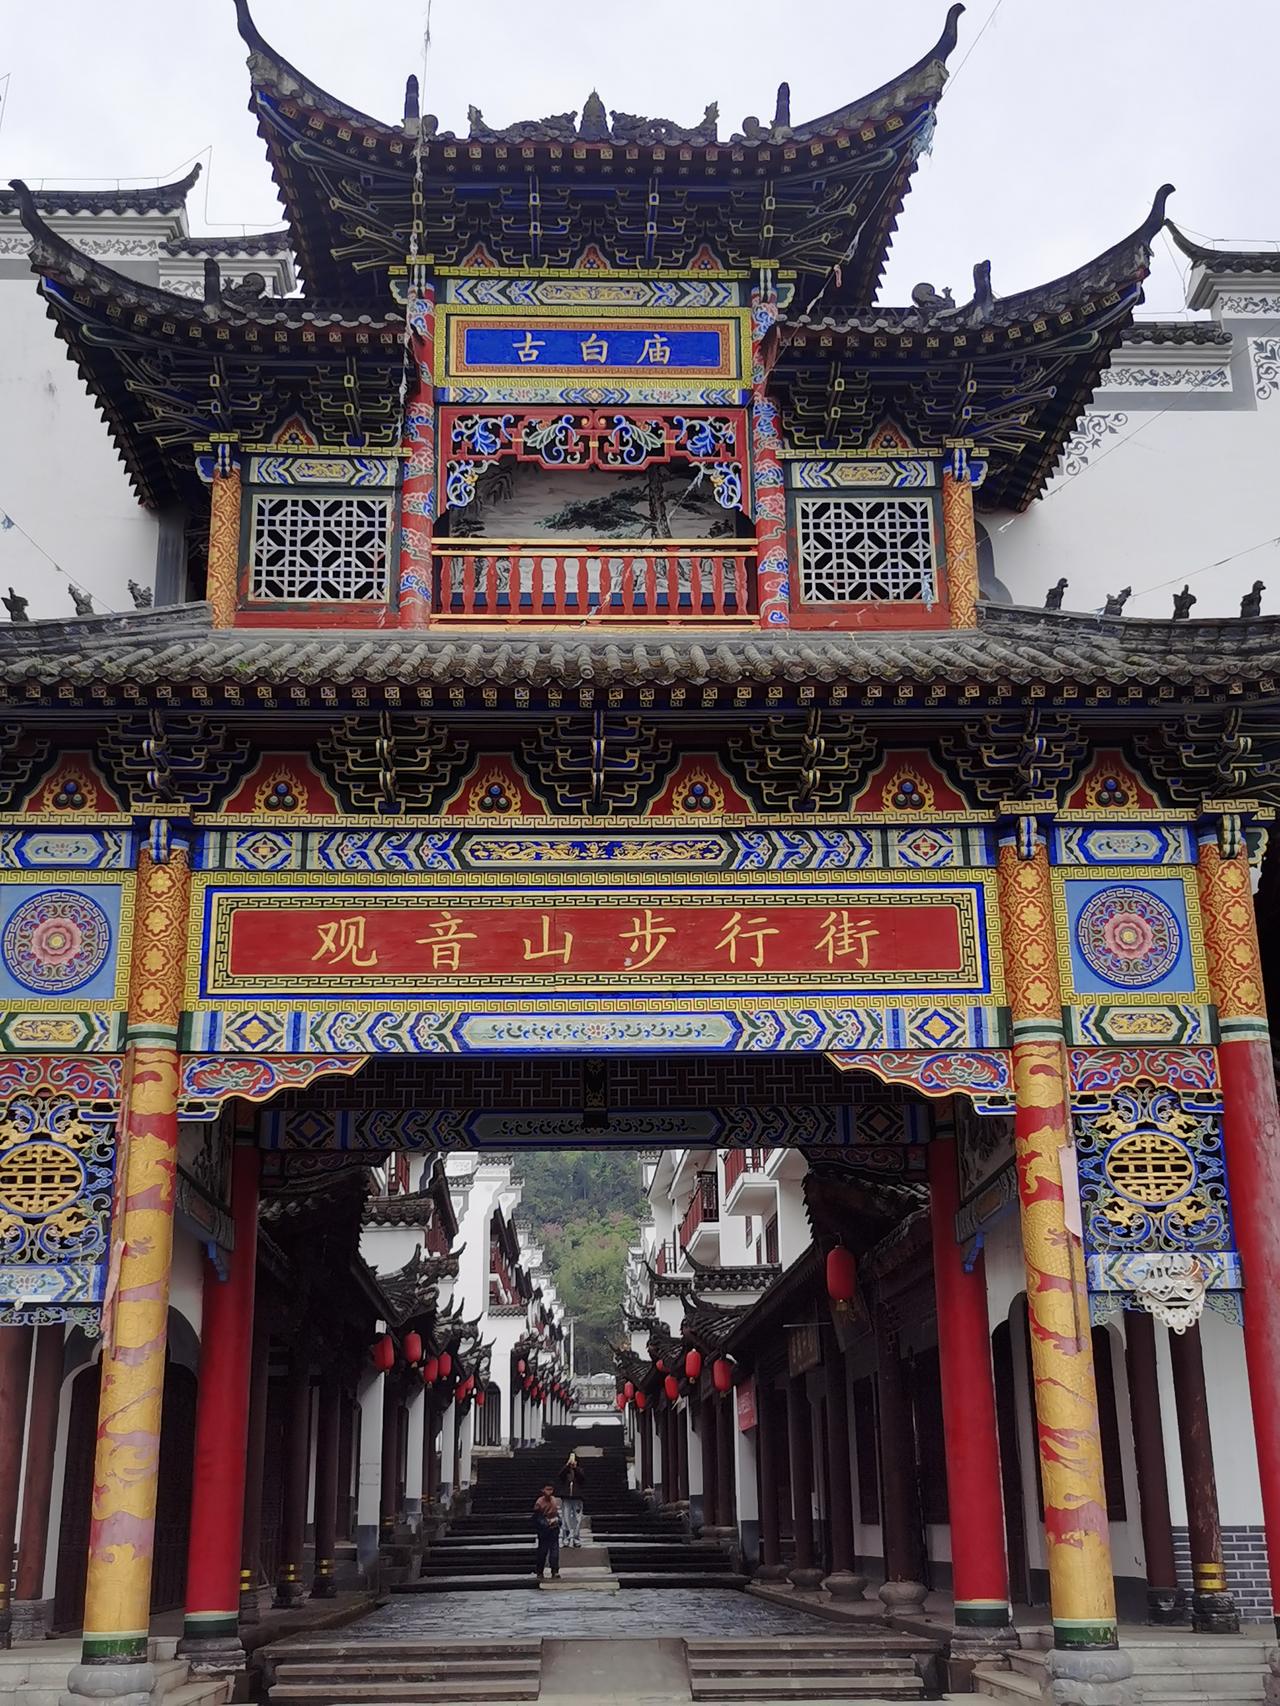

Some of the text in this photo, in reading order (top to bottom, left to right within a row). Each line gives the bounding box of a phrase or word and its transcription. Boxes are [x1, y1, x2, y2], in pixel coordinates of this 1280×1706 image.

[512, 331, 671, 365] 古白庙
[311, 908, 880, 972] 观音山步行街
